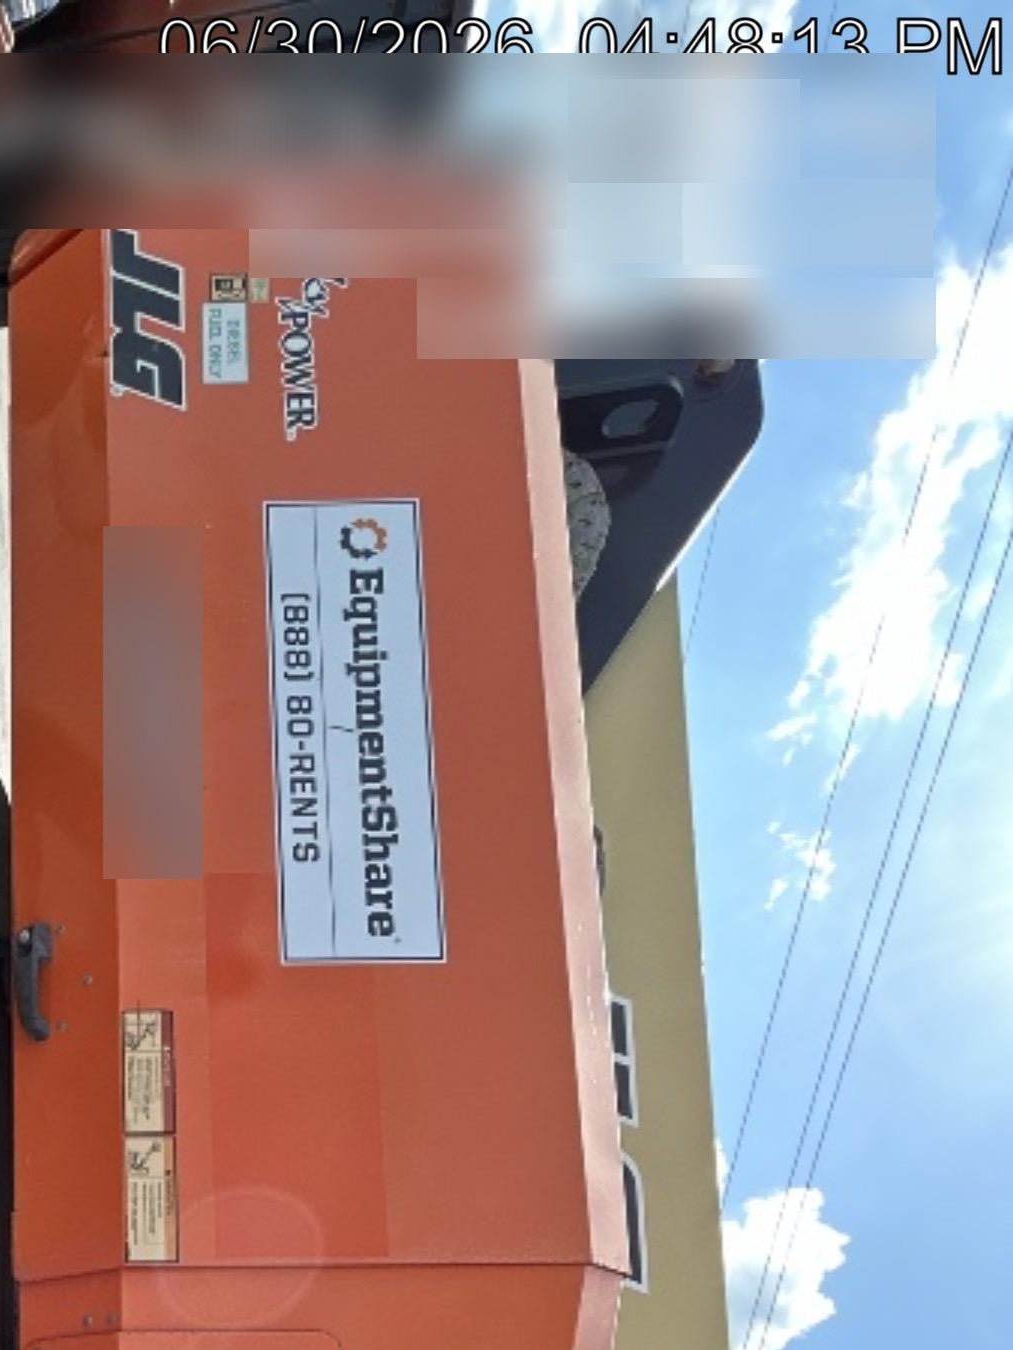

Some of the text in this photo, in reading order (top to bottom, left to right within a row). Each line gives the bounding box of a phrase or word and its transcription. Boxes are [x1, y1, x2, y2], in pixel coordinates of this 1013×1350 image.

[110, 229, 184, 410] JLG
[281, 592, 321, 864] (888) 80-RENTS
[342, 567, 400, 938] EquipmentShare
